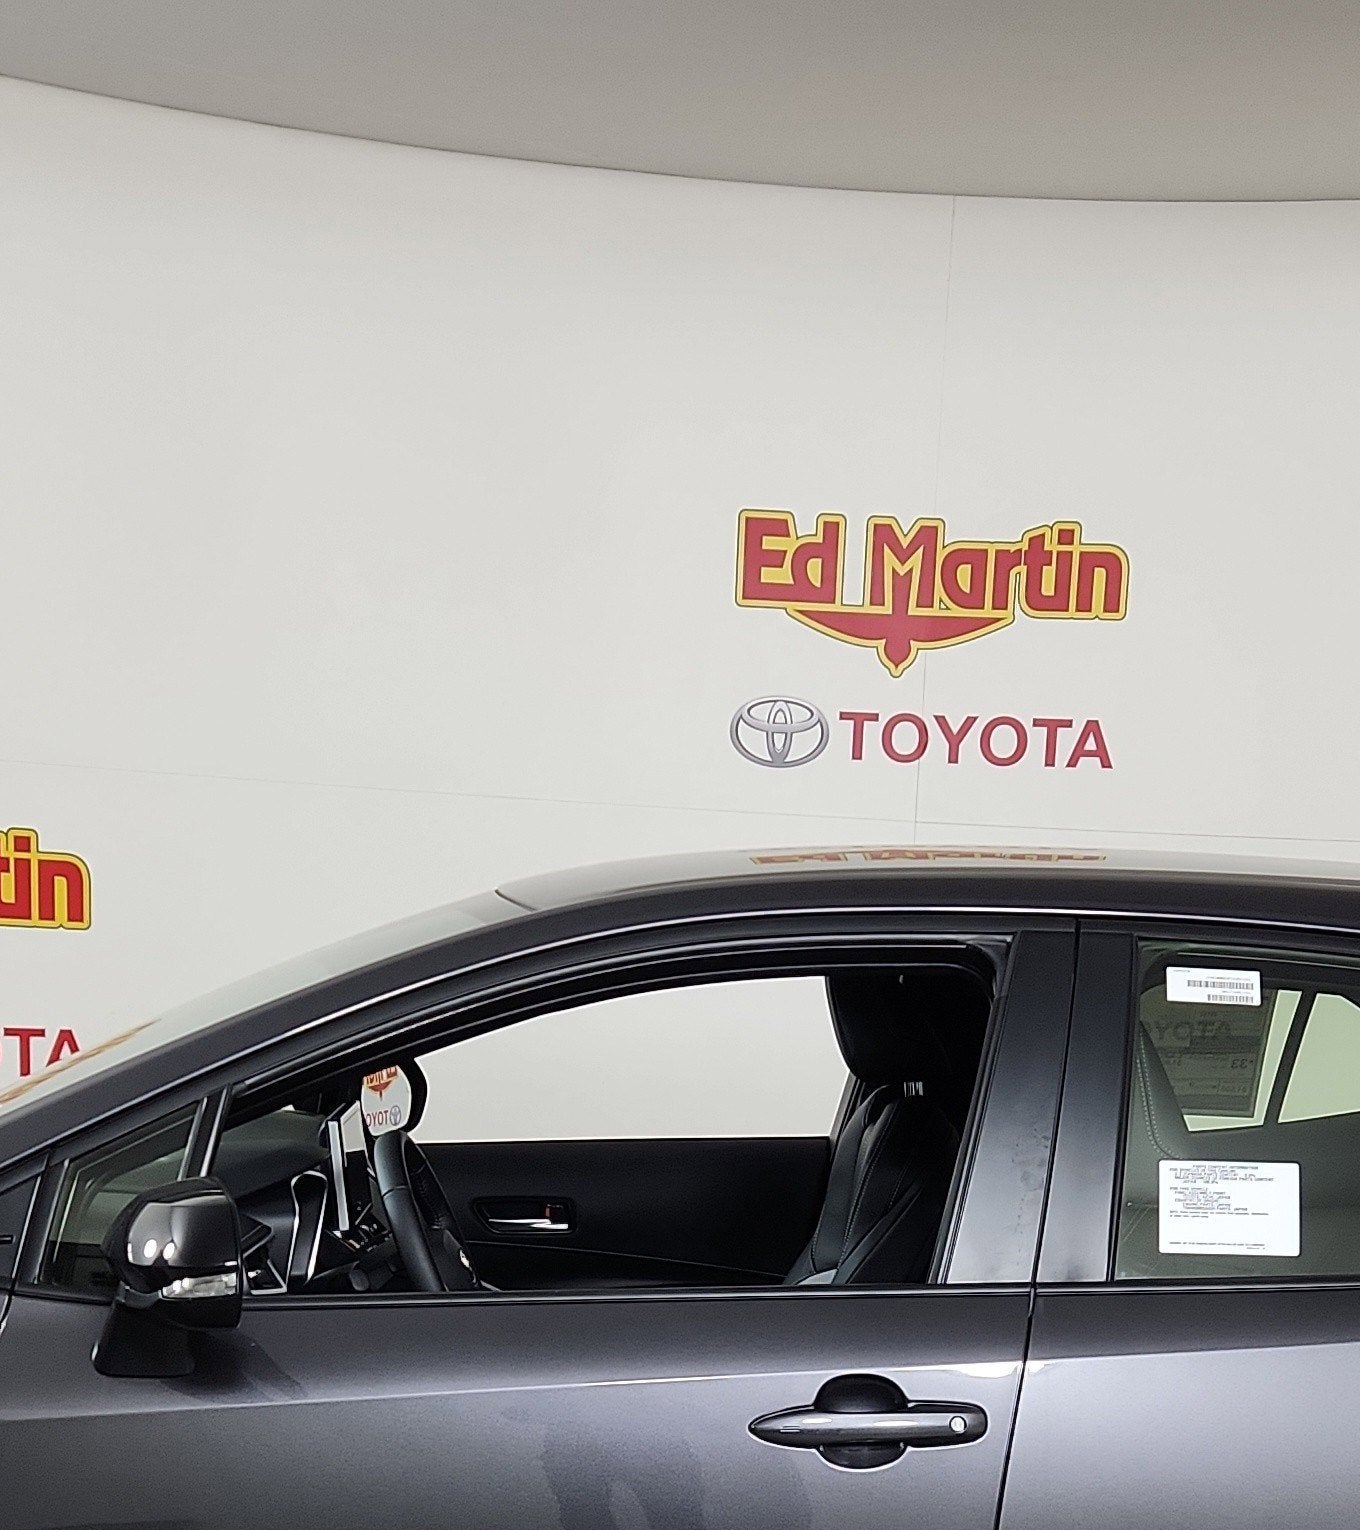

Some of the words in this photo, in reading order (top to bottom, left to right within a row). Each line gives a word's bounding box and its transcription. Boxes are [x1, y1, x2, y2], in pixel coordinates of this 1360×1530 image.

[737, 510, 847, 607] Ed
[868, 514, 1129, 620] Martin
[839, 711, 1113, 770] TOYOTA
